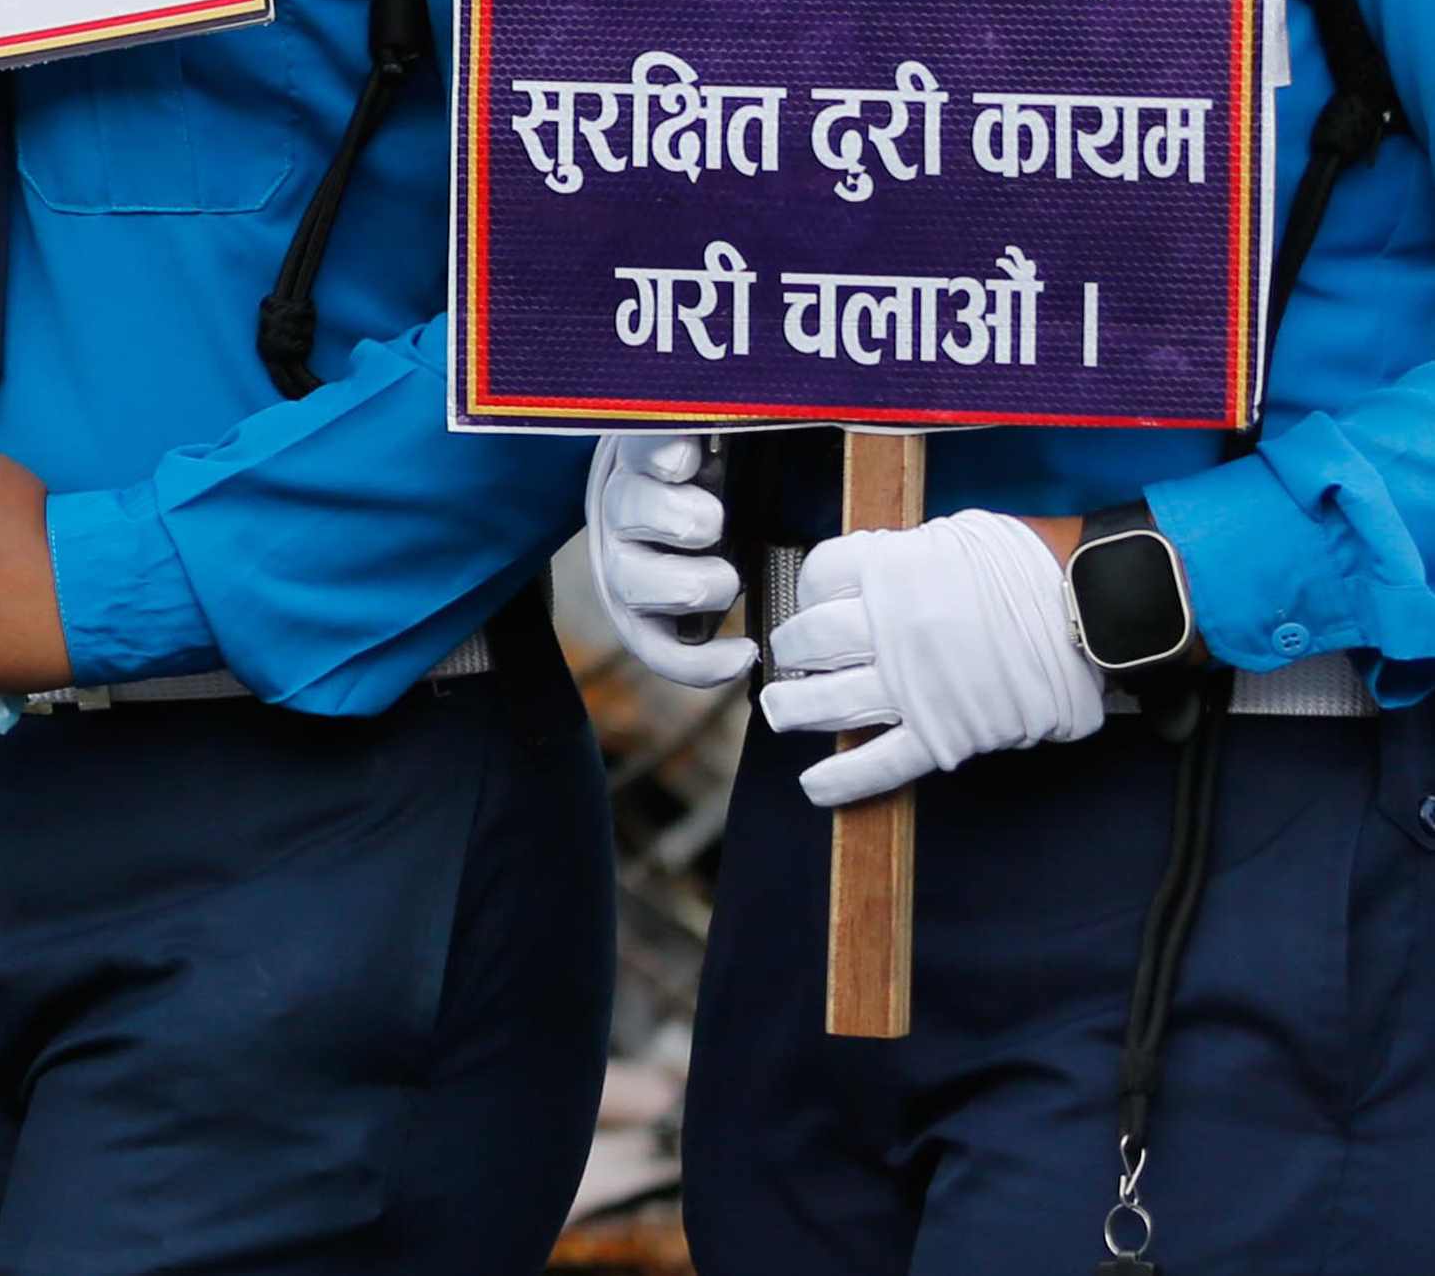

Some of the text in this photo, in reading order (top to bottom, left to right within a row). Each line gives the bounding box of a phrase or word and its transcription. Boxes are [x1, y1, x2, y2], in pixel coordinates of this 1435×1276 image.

[511, 50, 1214, 202] सुरक्षित दुरी कायम
[614, 240, 757, 360] गरी
